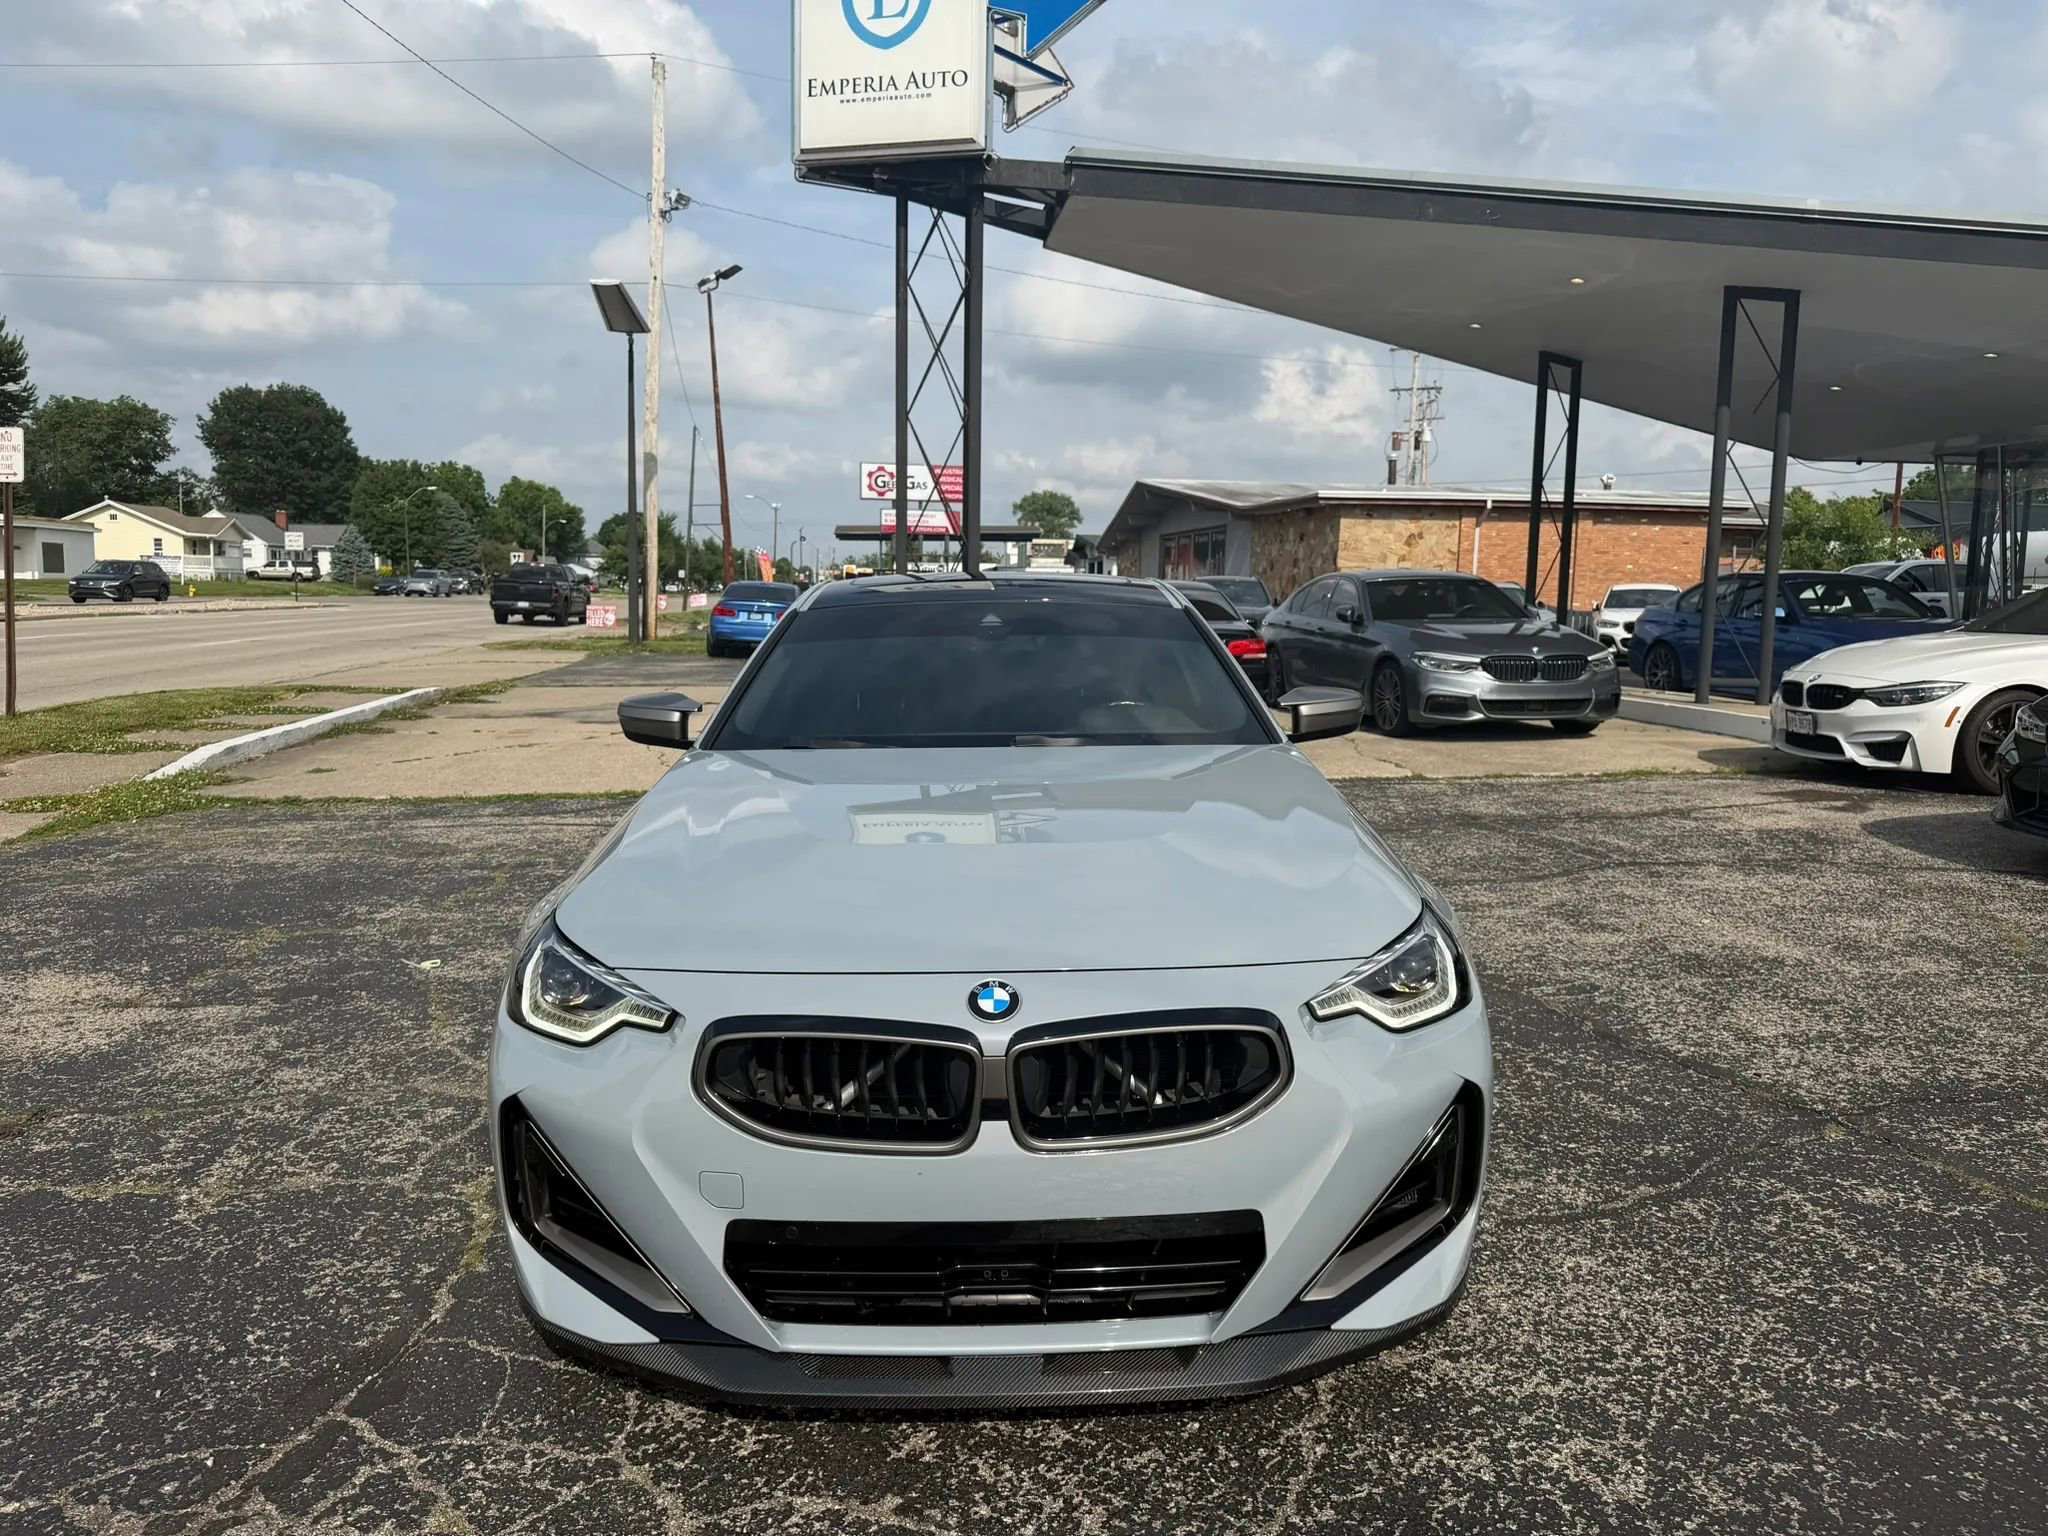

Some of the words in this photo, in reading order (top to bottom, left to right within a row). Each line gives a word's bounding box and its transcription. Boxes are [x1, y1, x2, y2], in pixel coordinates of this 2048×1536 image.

[807, 75, 899, 98] EMPERIA
[905, 69, 968, 90] AUTO
[839, 92, 932, 104] www.emperiaauto.com
[0, 432, 12, 442] NO
[0, 444, 21, 453] RKING
[586, 609, 605, 618] FILLED
[972, 980, 1016, 994] BMW
